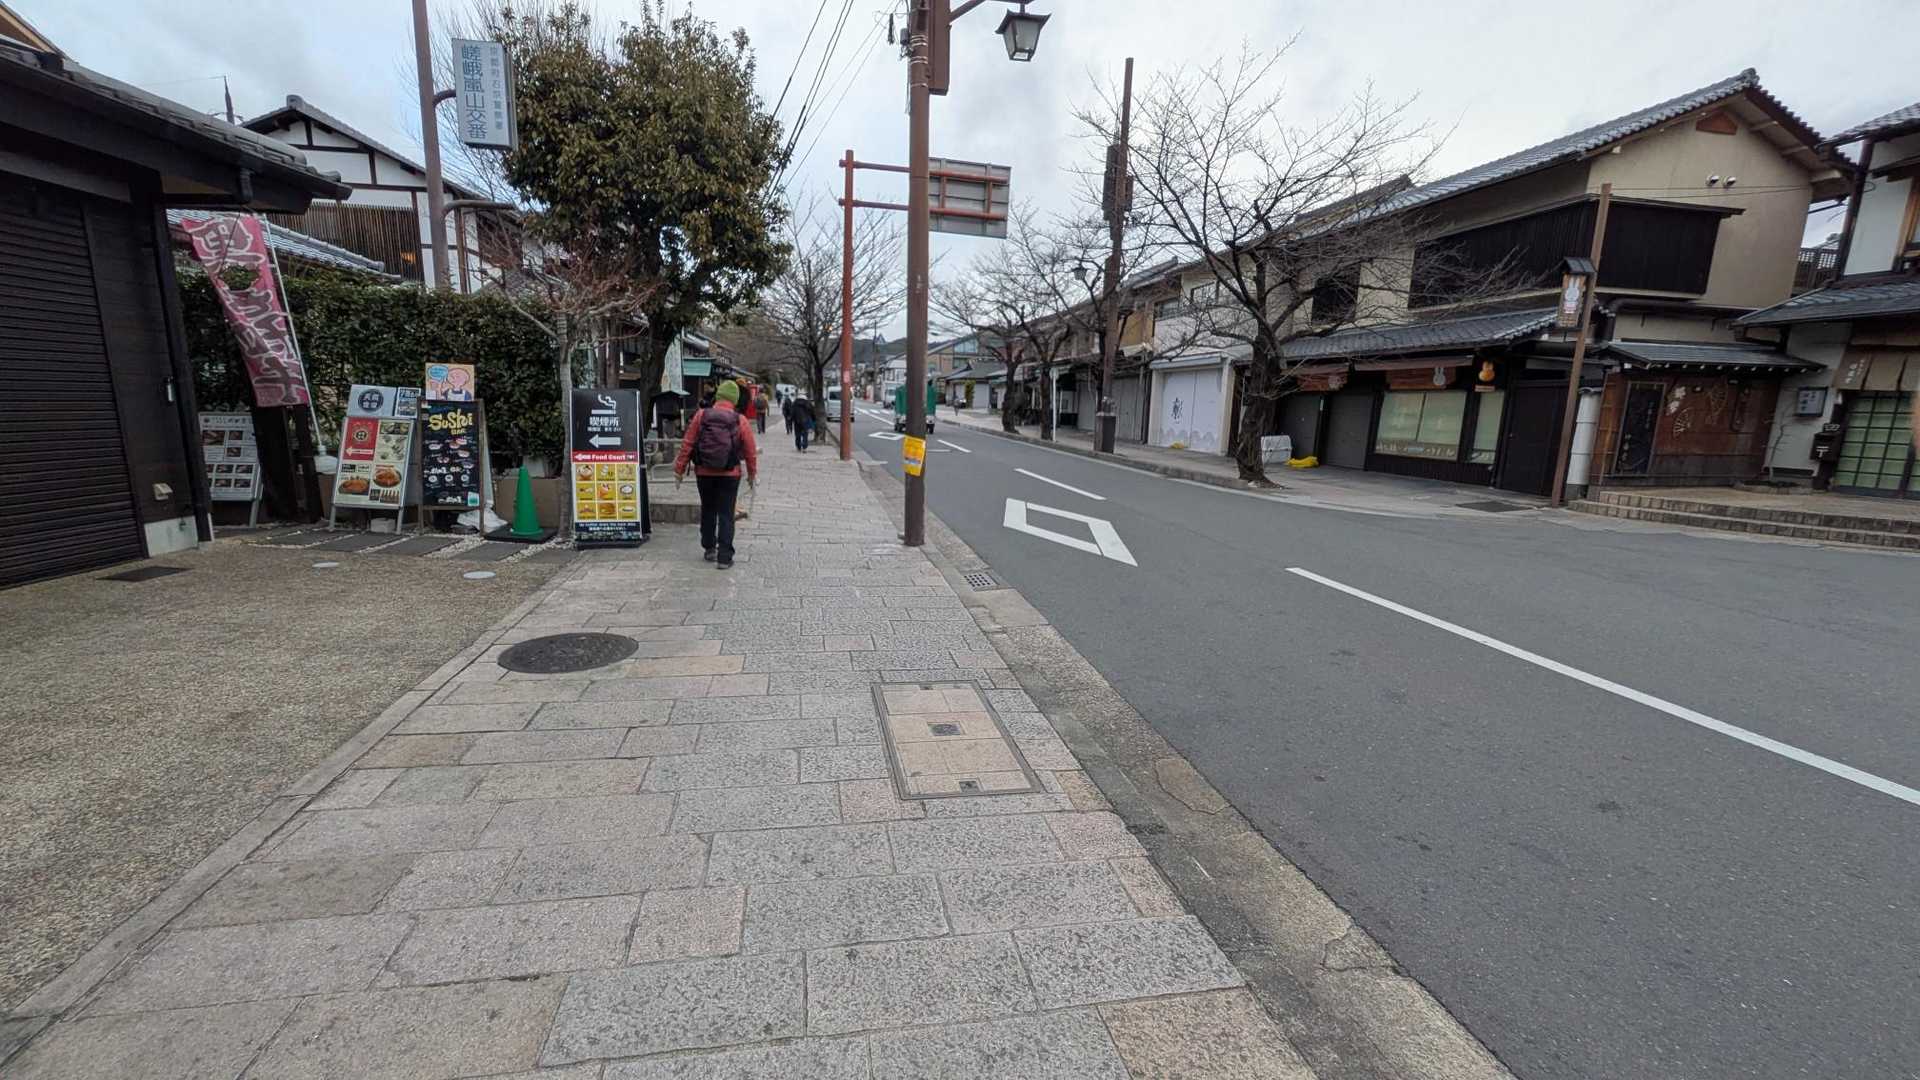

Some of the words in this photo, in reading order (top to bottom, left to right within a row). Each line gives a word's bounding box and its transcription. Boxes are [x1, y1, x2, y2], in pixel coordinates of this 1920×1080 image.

[462, 44, 488, 139] 嵯峨嵐山交番
[589, 416, 619, 427] 喫煙所
[591, 453, 608, 461] Food
[608, 453, 626, 461] Court
